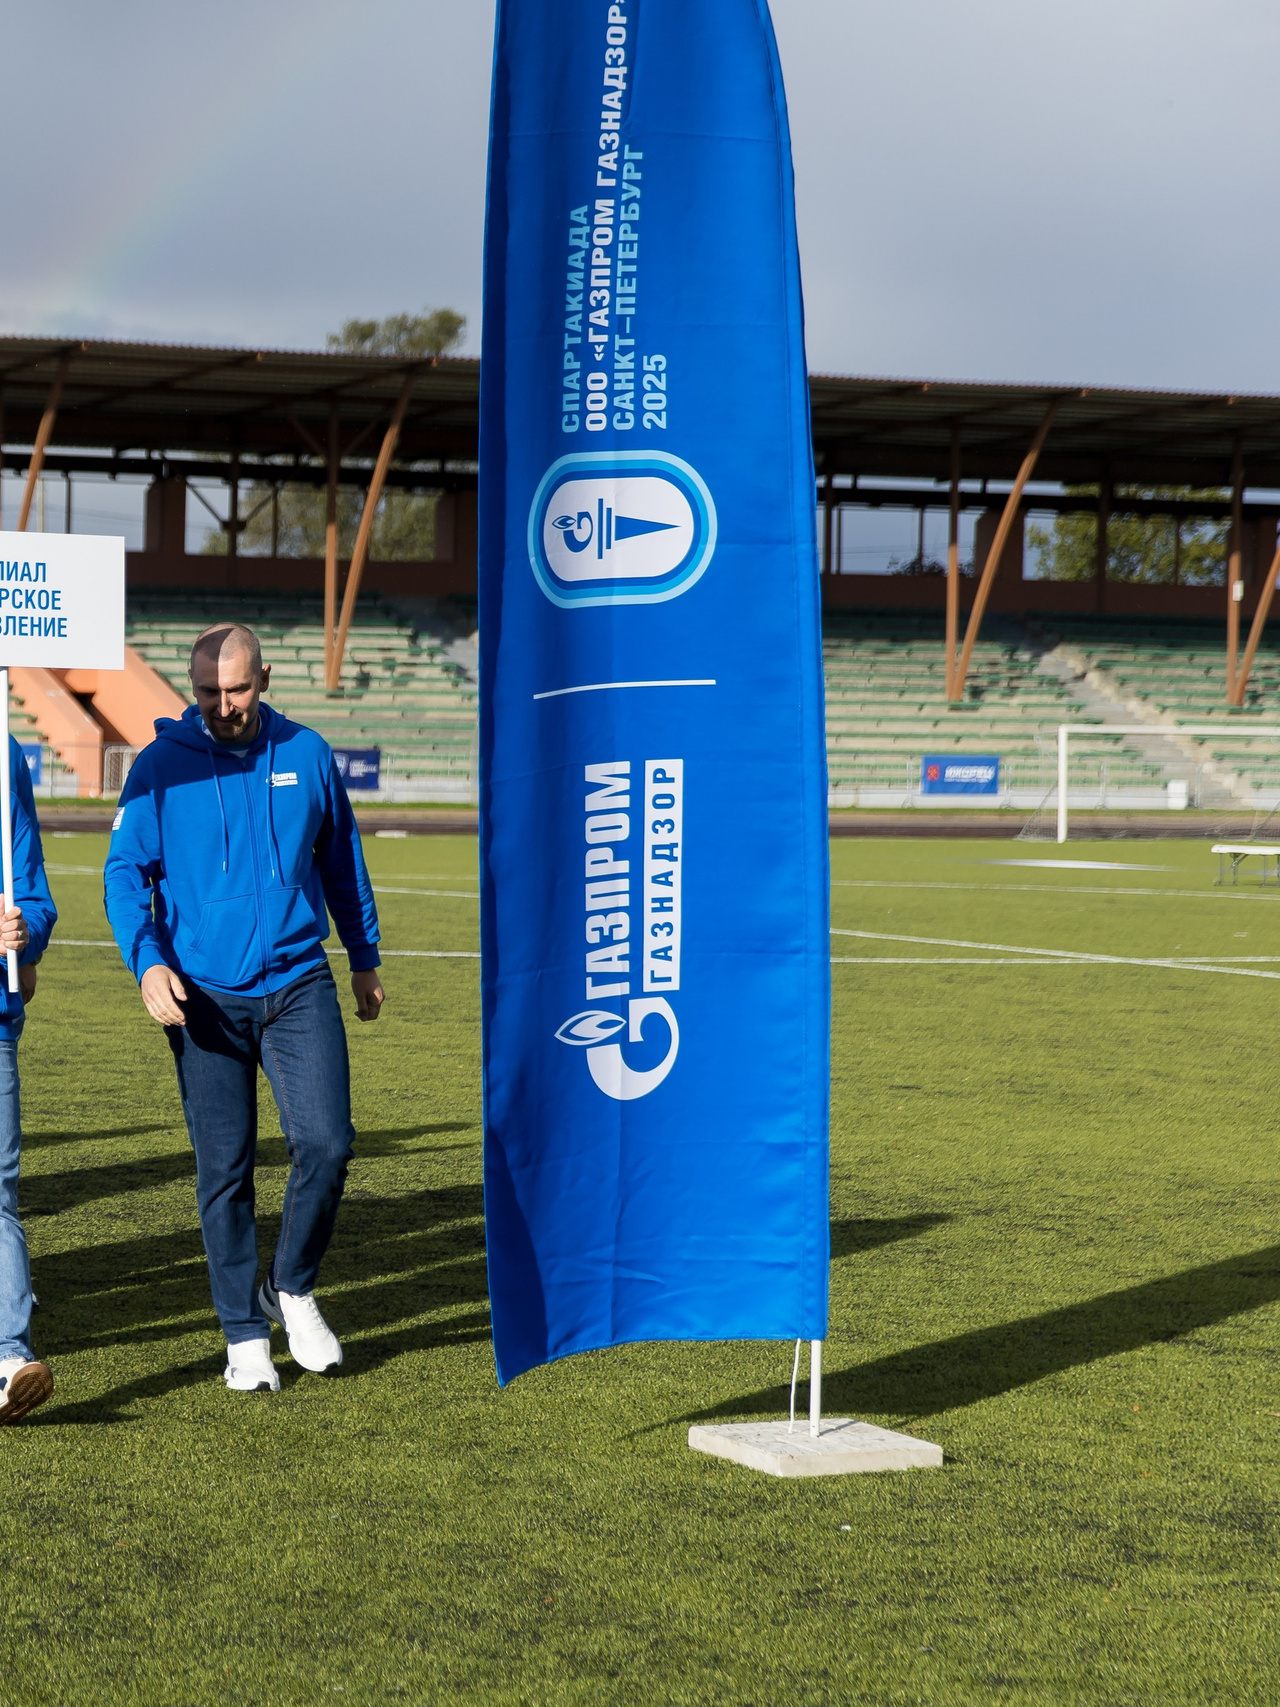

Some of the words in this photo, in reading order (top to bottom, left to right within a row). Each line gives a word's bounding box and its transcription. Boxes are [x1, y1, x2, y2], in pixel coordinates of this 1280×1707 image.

[596, 0, 628, 187] ГАЗНАДЗОР
[561, 205, 591, 433] СПАРТАКИАДА
[588, 199, 615, 361] «ГАЗПРОМ
[585, 372, 608, 432] ООО
[642, 354, 667, 430] 2025
[584, 760, 631, 1001] ГАЗПРОМ
[650, 767, 678, 984] ГАЗНАДЗОР
